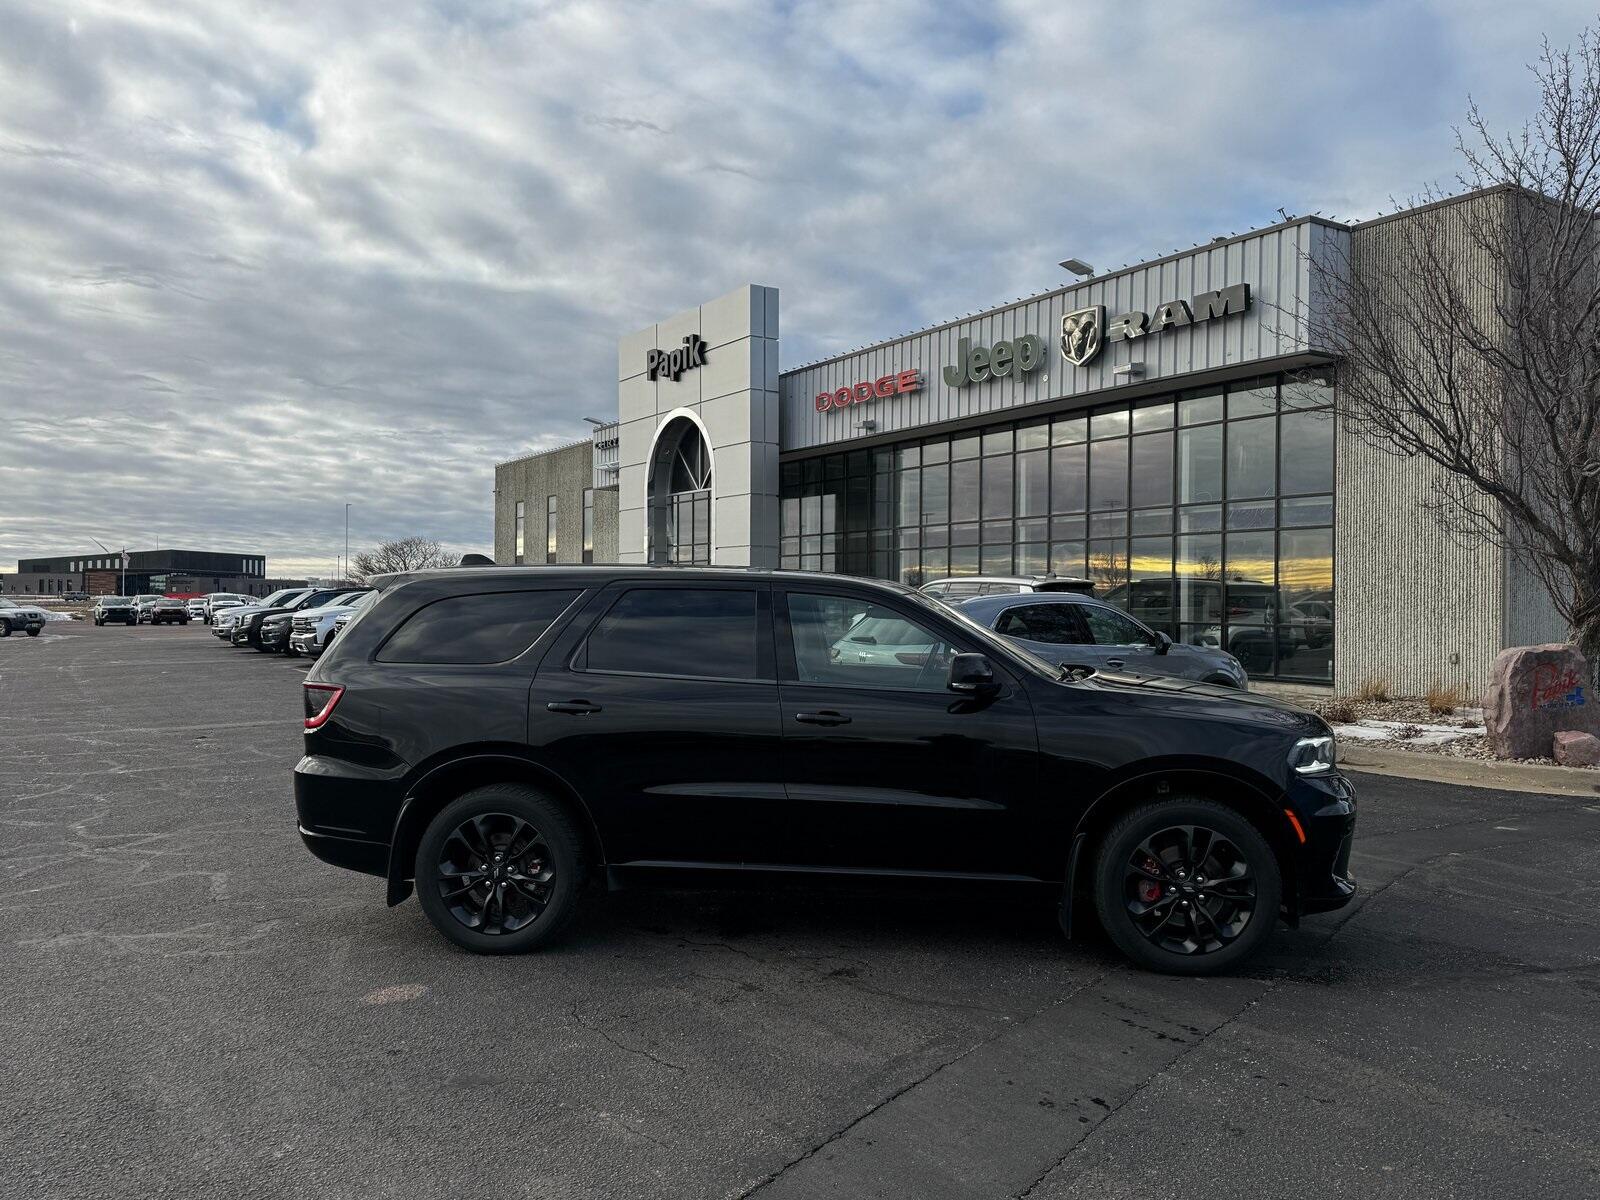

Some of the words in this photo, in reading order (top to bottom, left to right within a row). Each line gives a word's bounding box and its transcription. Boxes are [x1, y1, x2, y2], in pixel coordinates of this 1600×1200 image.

[1110, 283, 1250, 343] RAM
[647, 334, 708, 382] Papik
[943, 334, 1045, 388] Jeep
[815, 368, 921, 413] DODGE
